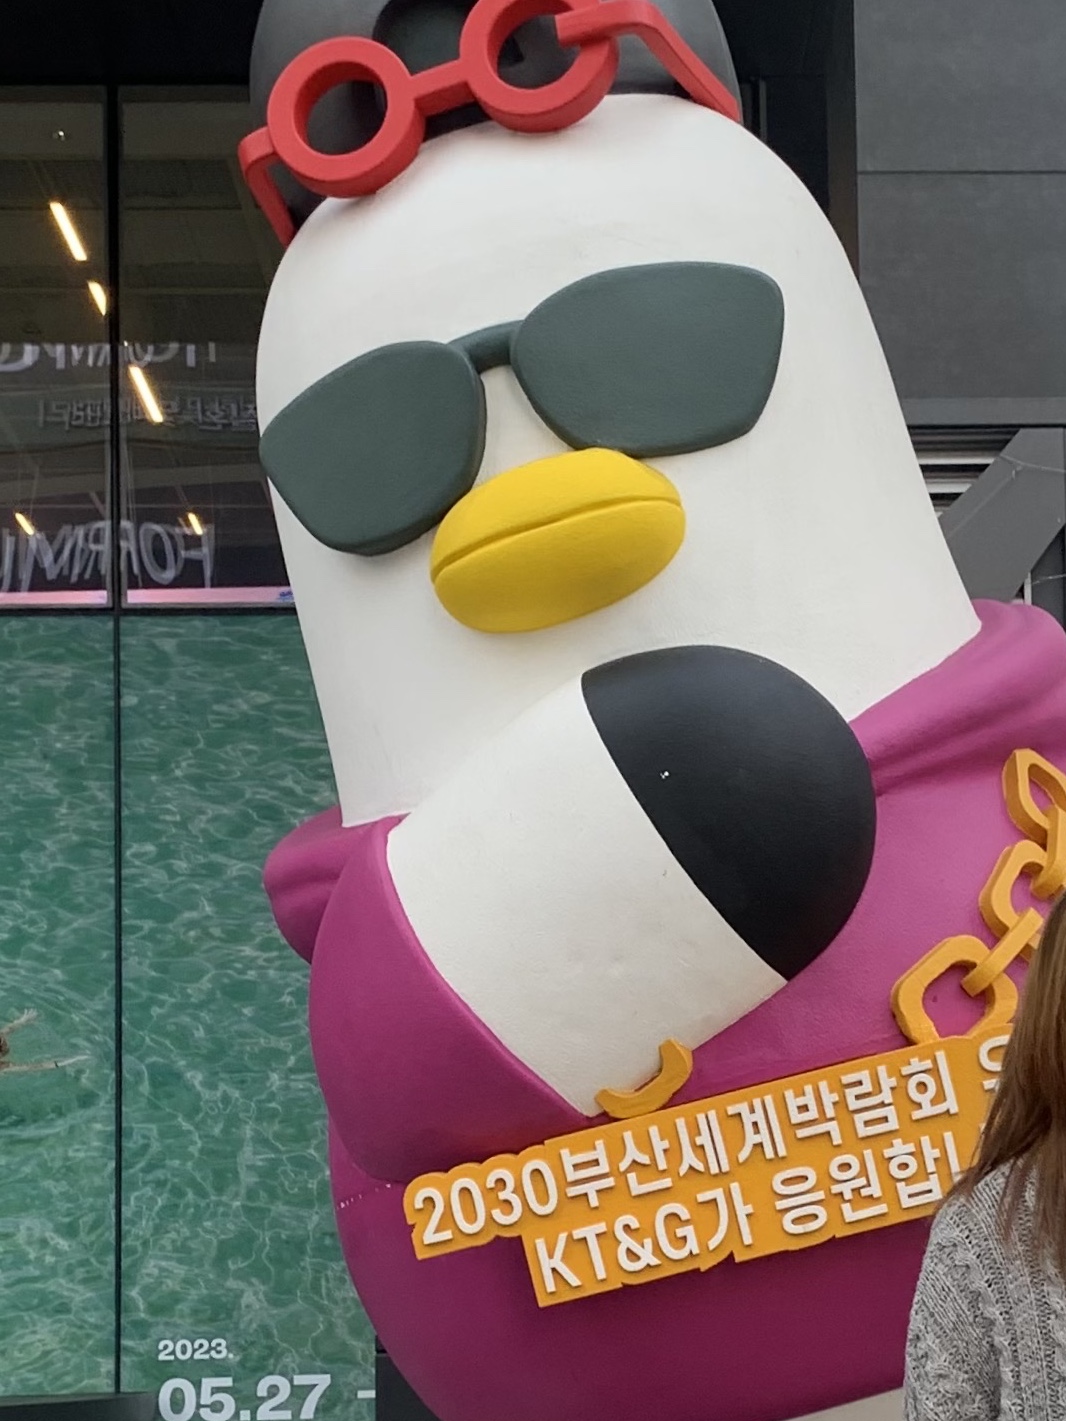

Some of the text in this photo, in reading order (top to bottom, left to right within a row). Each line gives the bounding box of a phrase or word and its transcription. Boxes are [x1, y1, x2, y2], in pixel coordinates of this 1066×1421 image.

[414, 1050, 960, 1246] 2030부산세계박람회
[534, 1182, 754, 1294] KT&G가
[157, 1338, 234, 1362] 2023.
